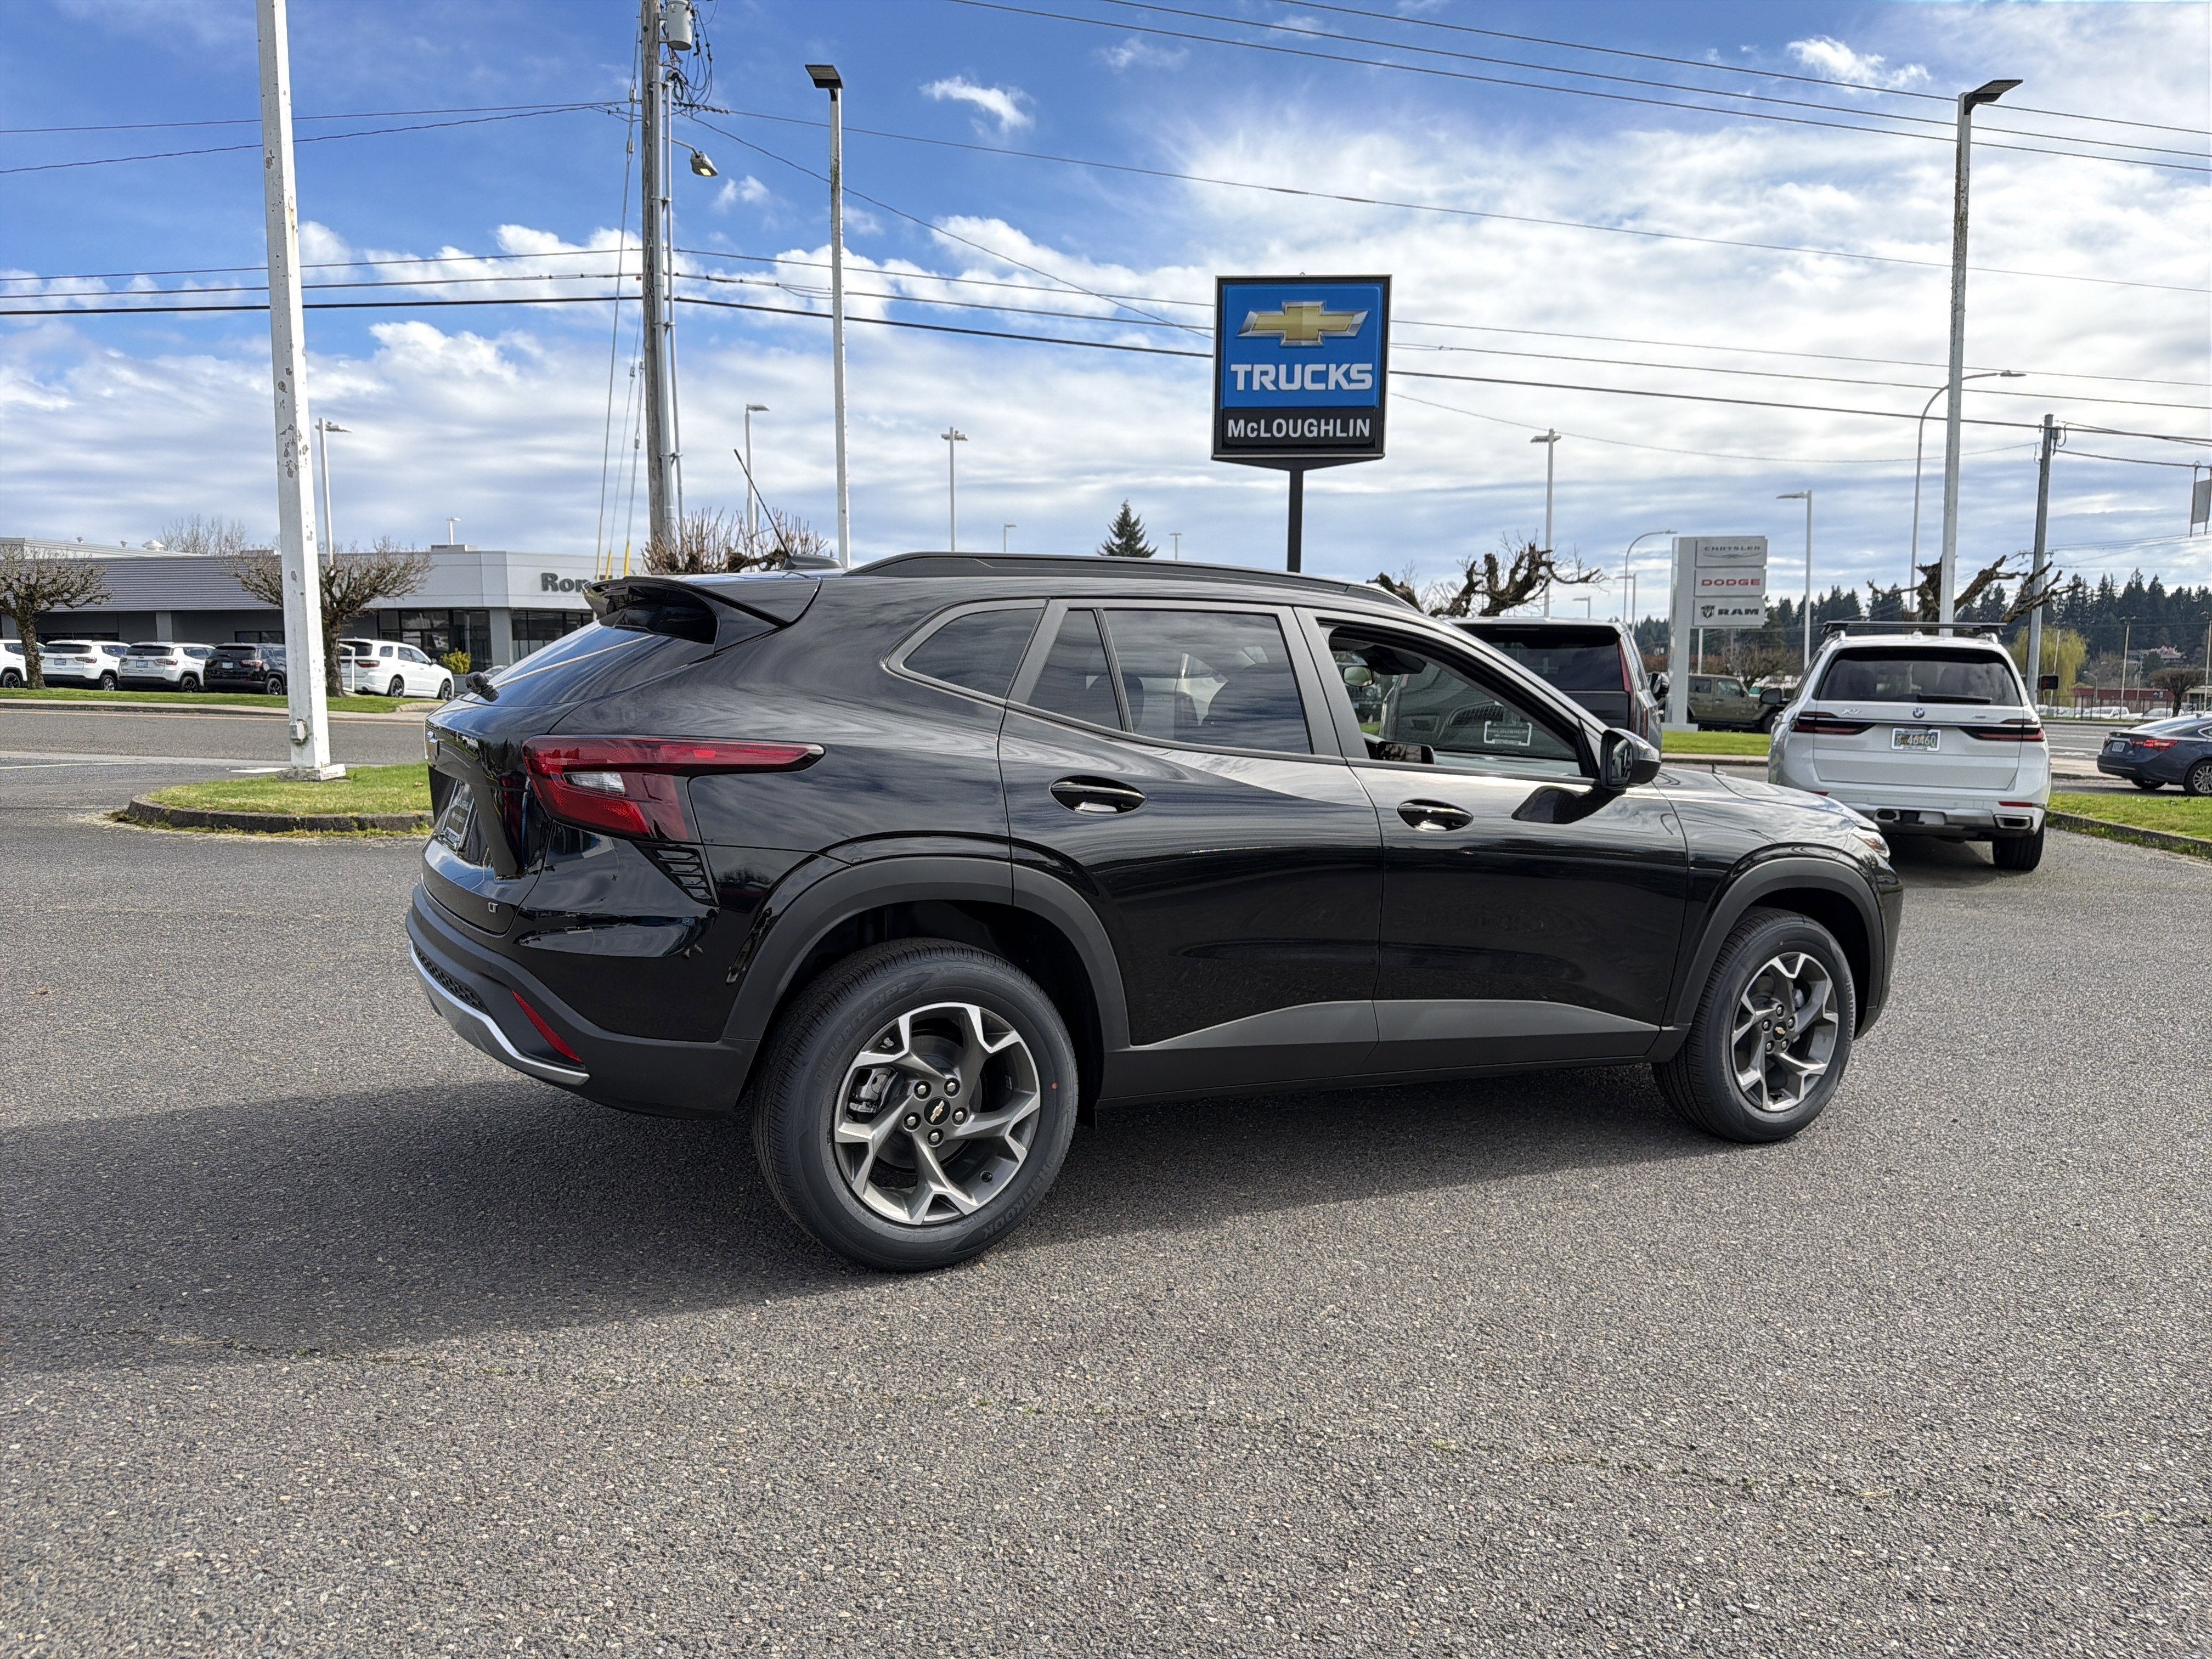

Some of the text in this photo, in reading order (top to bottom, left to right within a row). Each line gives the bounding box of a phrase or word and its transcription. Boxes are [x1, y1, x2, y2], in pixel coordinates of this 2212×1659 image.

[1230, 363, 1373, 391] TRUCKS
[1228, 418, 1370, 438] McLOUGHLIN
[1701, 578, 1760, 586] DODGE
[488, 901, 499, 913] LT
